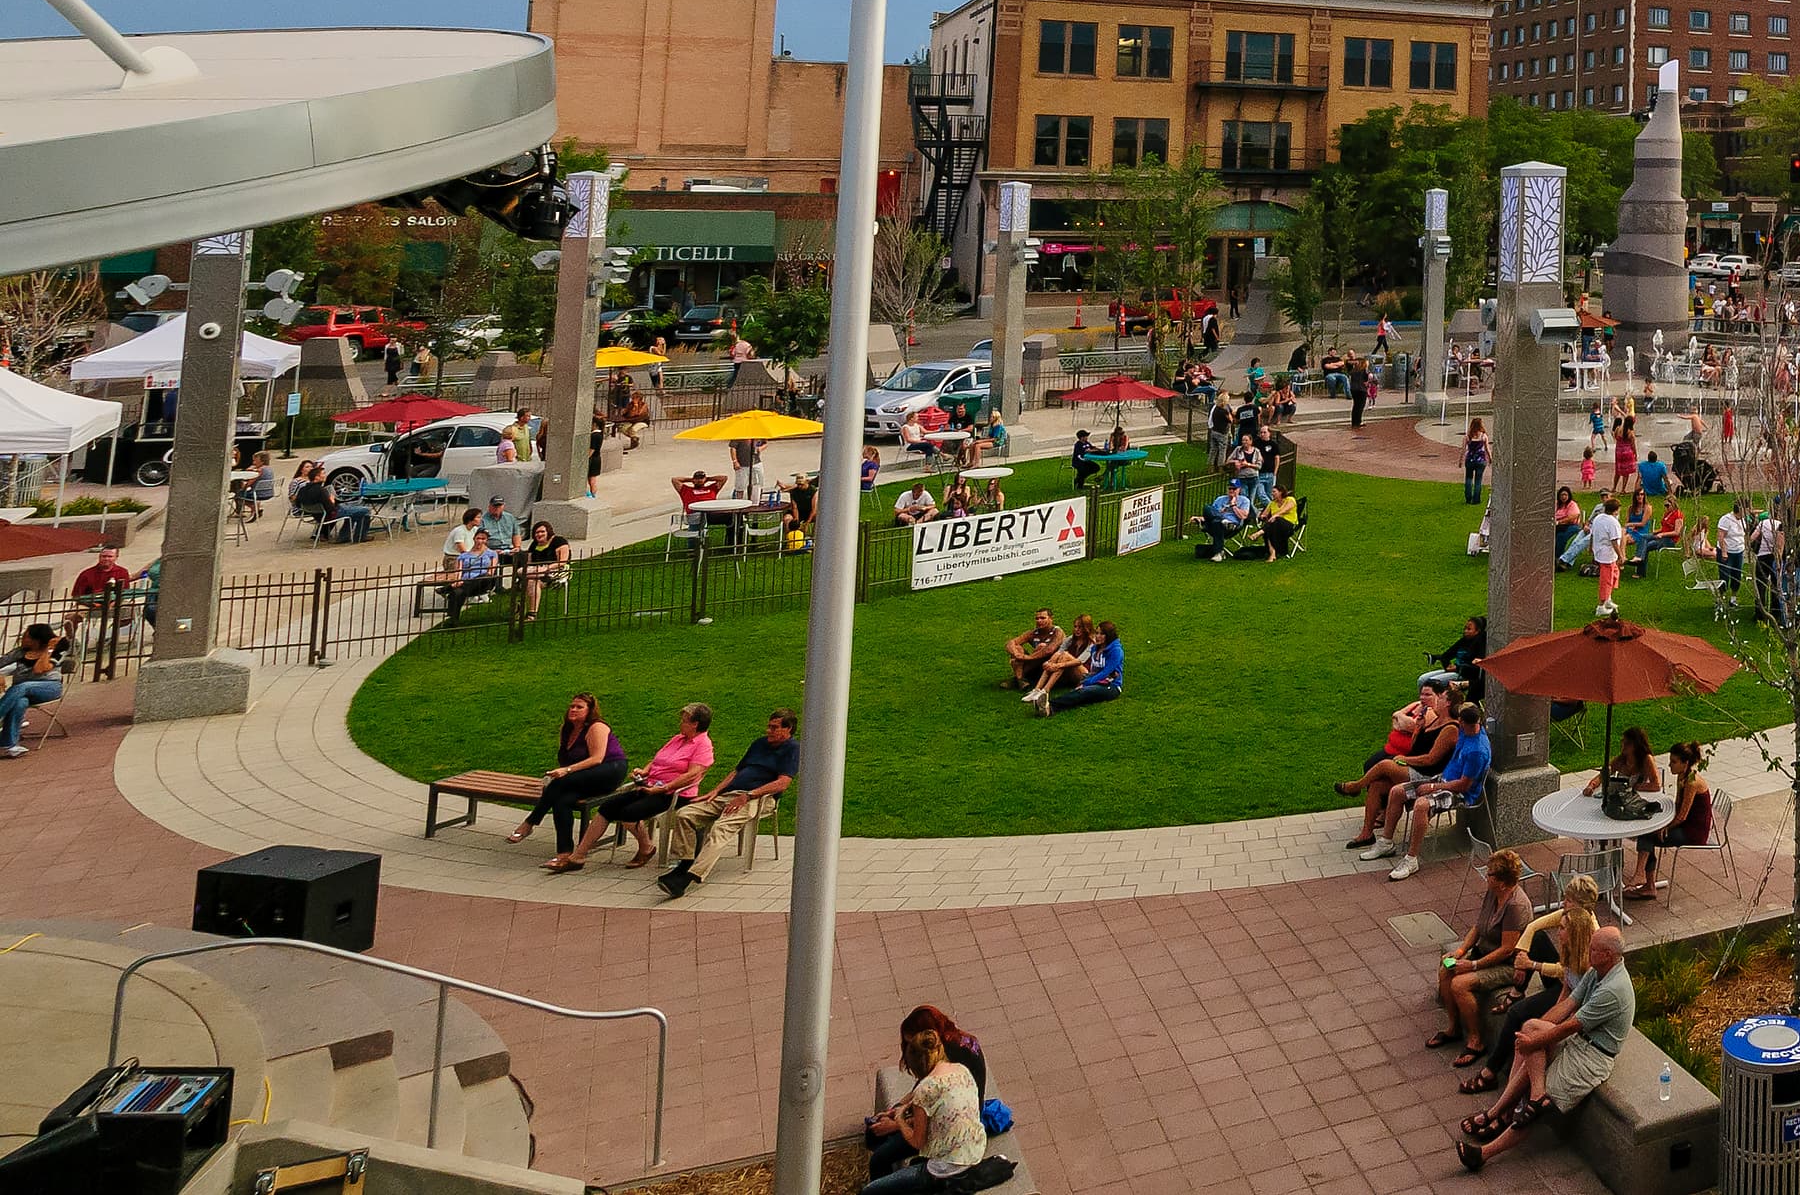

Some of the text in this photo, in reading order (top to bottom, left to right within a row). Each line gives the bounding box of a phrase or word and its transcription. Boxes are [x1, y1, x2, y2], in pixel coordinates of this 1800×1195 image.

[407, 216, 457, 226] SALON
[1133, 495, 1152, 508] FREE
[1123, 502, 1161, 521] ADMITTANCE
[916, 506, 1055, 555] LIBERTY
[936, 548, 1039, 571] Libertymitsubishi.com
[914, 573, 953, 586] 716-7777
[1734, 1019, 1786, 1037] RECYCLE
